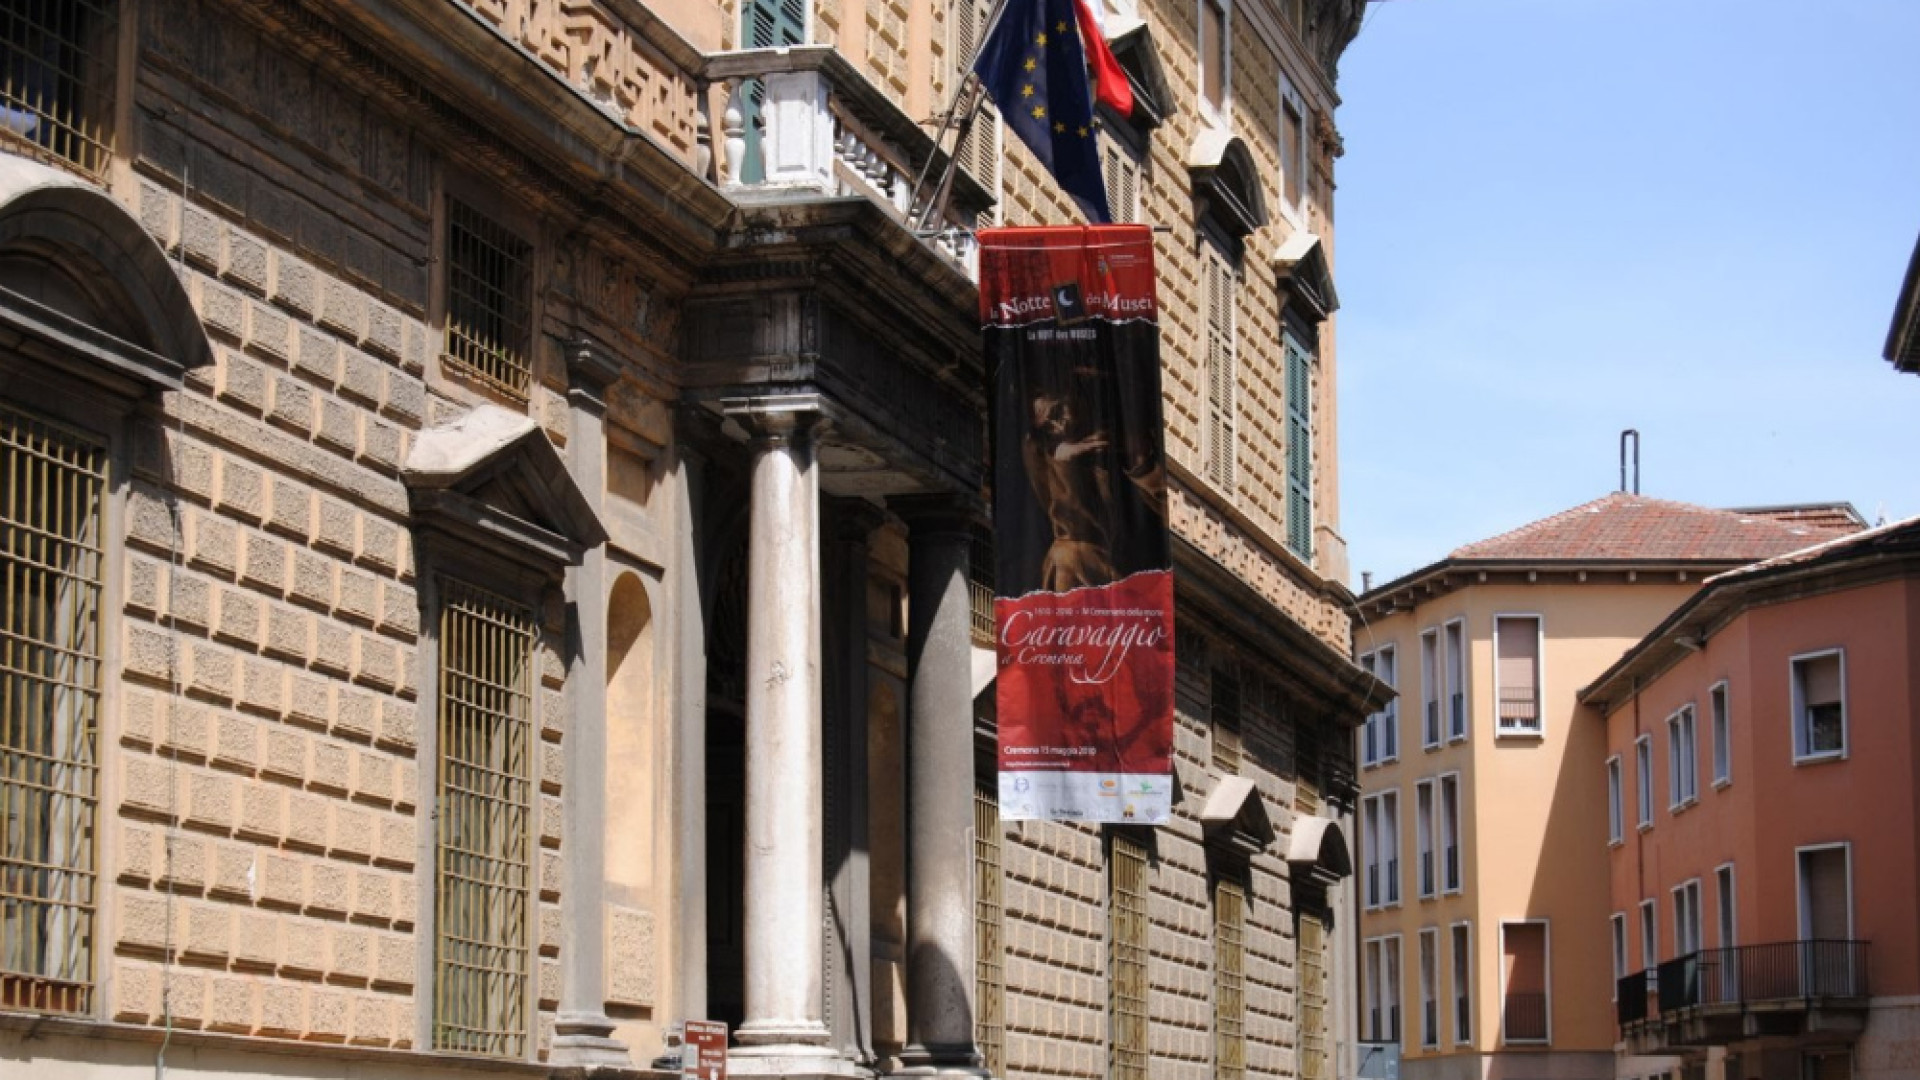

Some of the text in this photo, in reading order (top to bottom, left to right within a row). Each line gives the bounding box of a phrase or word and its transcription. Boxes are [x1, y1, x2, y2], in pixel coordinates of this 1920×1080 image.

[1000, 295, 1052, 320] Notte
[1103, 291, 1153, 312] Musei
[1001, 609, 1168, 684] Caravaggio
[1017, 646, 1084, 665] Cremona
[1003, 746, 1039, 755] Cremona
[1050, 747, 1078, 756] maggio
[1078, 746, 1097, 756] 2010
